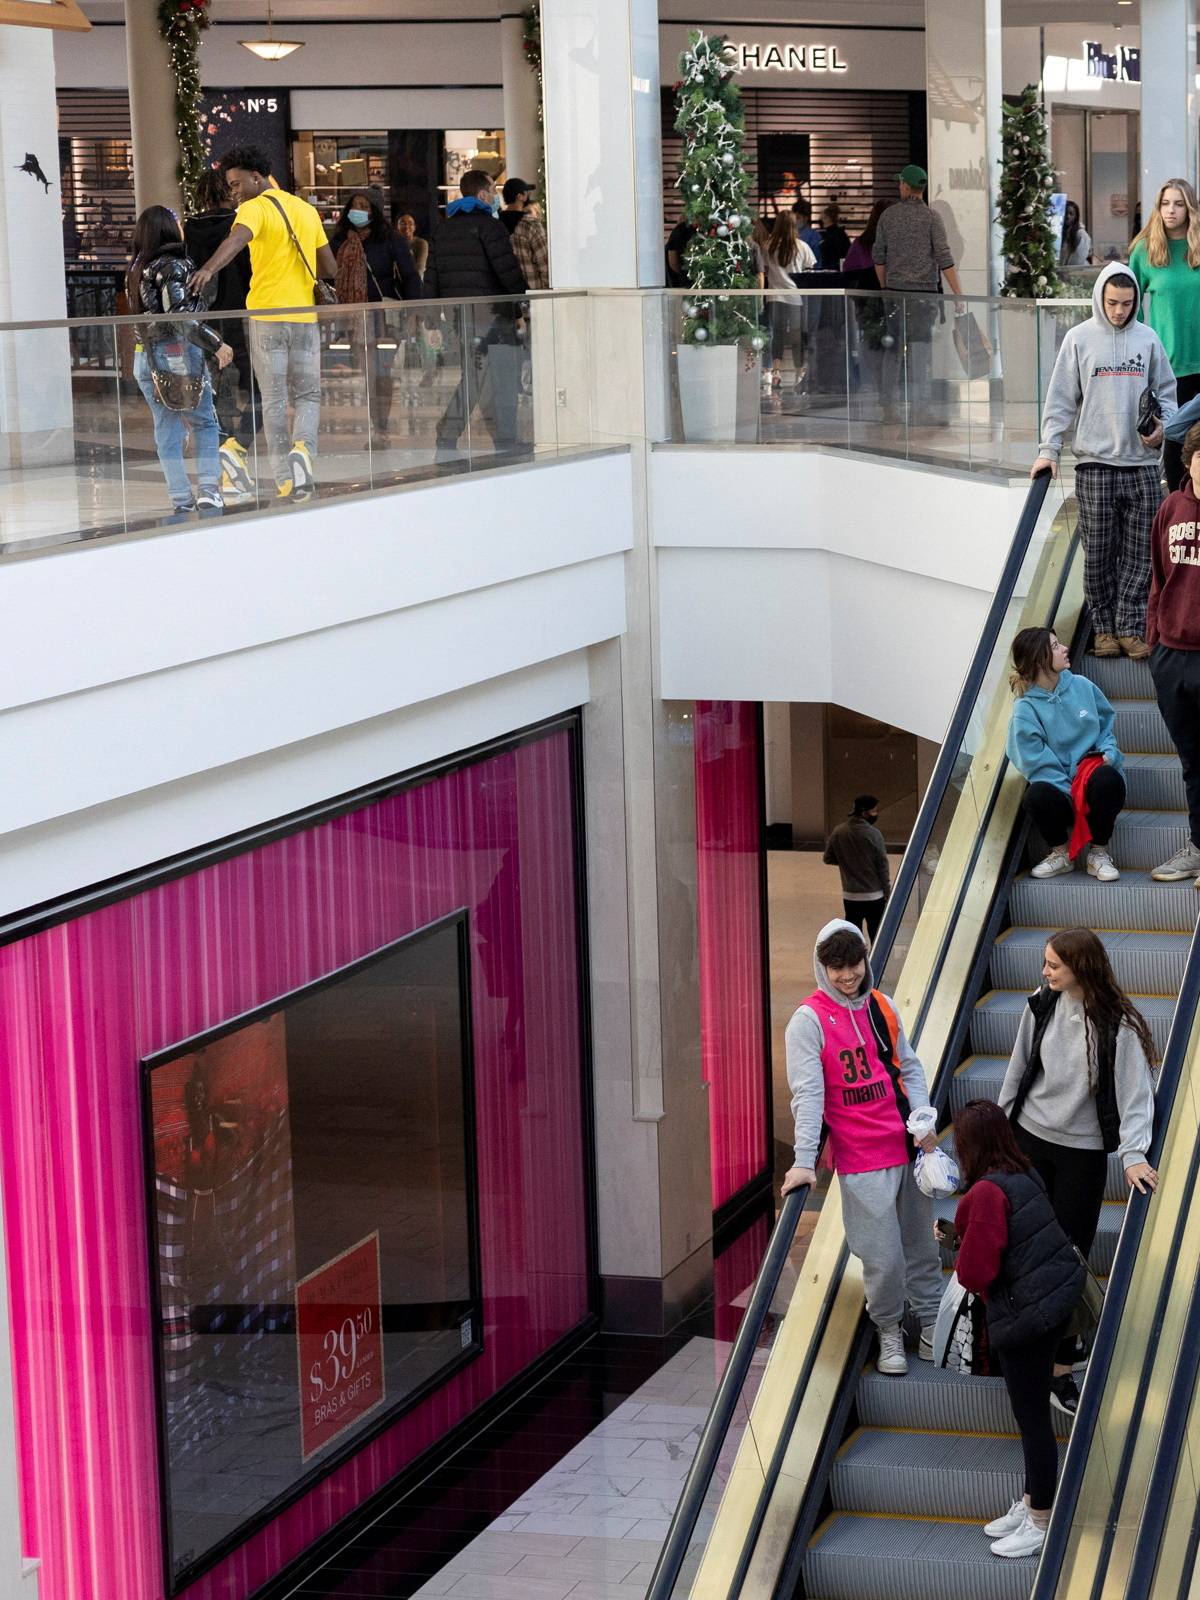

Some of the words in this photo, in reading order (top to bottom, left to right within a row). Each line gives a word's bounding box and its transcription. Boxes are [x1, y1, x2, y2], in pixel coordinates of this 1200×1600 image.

[1117, 46, 1140, 83] Ni
[839, 1046, 872, 1084] 33
[314, 1396, 338, 1426] BRAS
[339, 1391, 347, 1408] &
[347, 1371, 371, 1401] GIFTS
